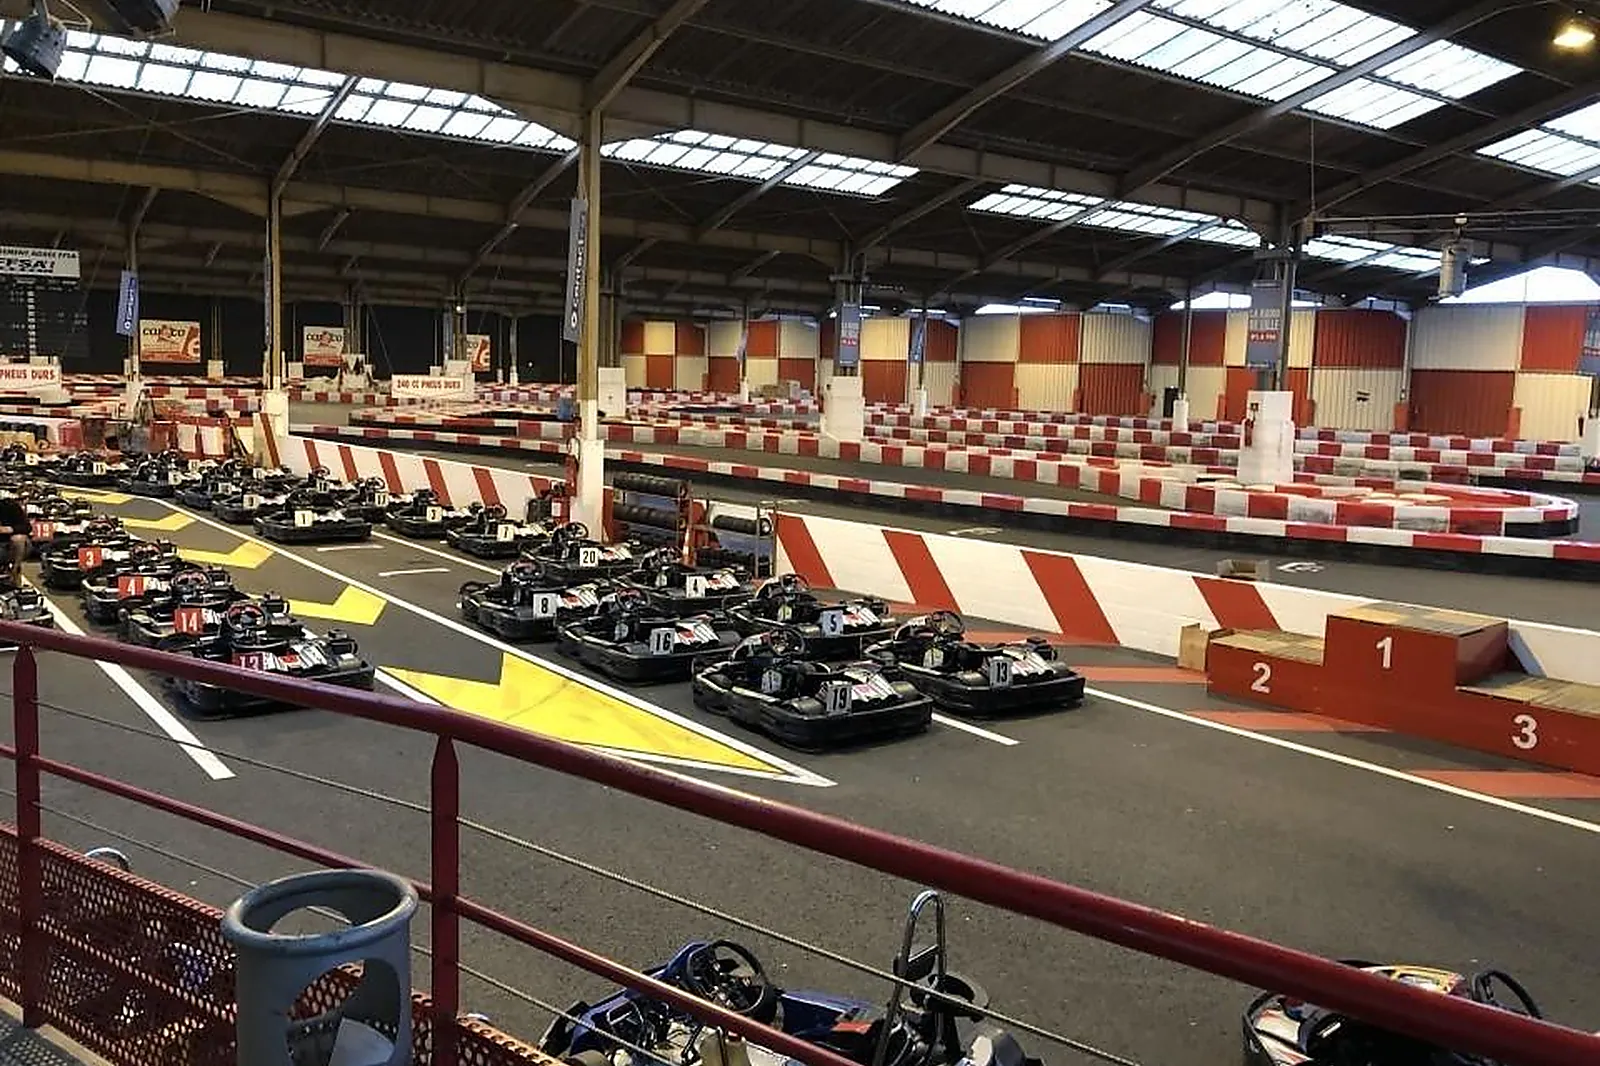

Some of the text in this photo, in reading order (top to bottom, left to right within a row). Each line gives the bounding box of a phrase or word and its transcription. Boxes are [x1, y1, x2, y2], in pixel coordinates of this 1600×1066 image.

[31, 369, 55, 380] DURS
[85, 550, 95, 567] 3
[582, 550, 596, 565] 20
[127, 577, 137, 597] 4
[540, 596, 549, 615] 8
[179, 610, 198, 633] 14
[829, 613, 838, 633] 5
[655, 632, 672, 651] 16
[1375, 636, 1393, 669] 1
[995, 661, 1008, 683] 13
[1249, 661, 1273, 694] 2
[832, 687, 848, 711] 19
[1511, 714, 1538, 750] 3
